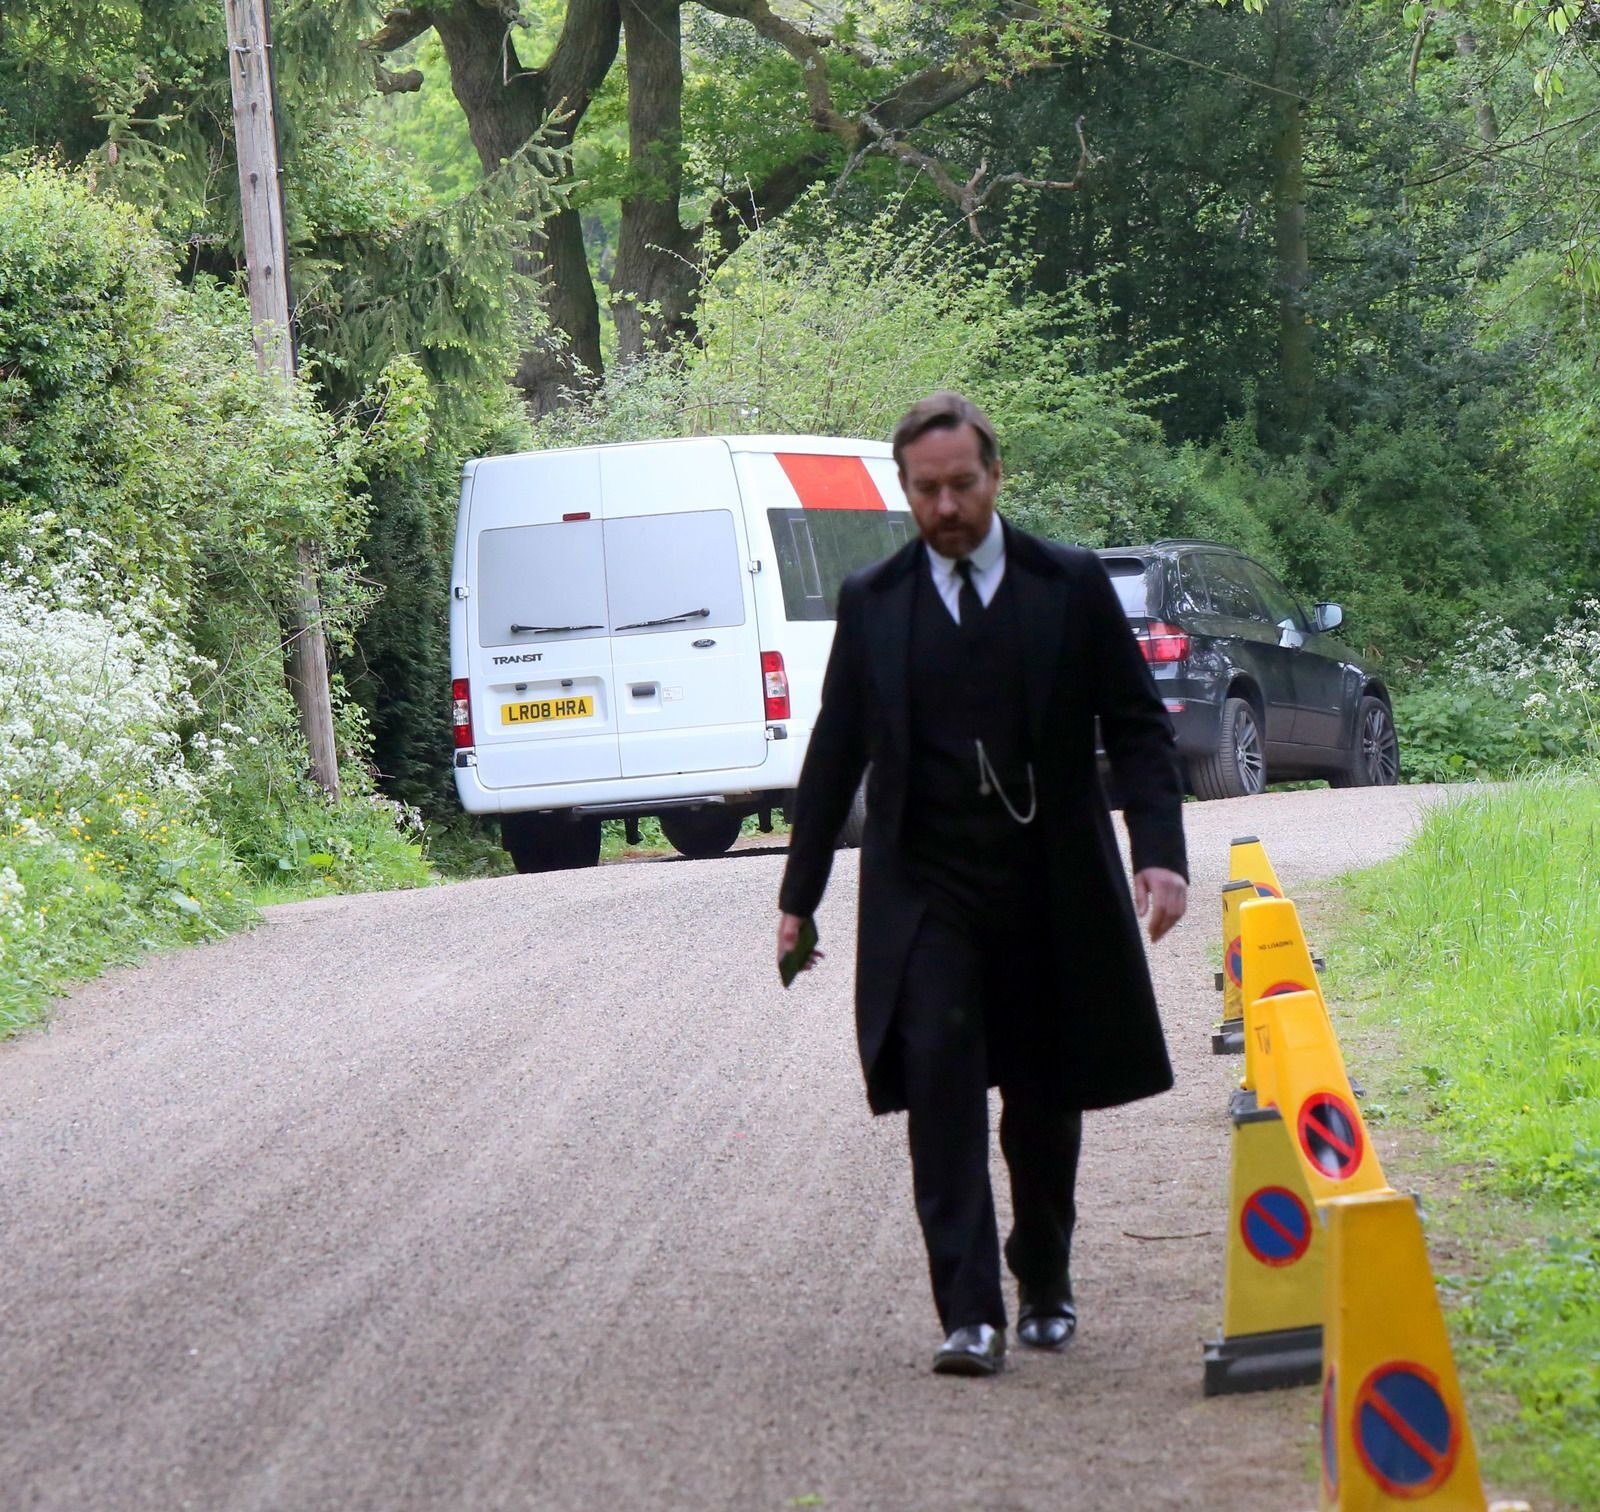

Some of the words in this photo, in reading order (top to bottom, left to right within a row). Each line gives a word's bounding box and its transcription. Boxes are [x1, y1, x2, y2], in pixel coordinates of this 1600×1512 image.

[492, 653, 543, 665] TRANSIT
[508, 703, 551, 721] LR08
[555, 699, 587, 716] HRA
